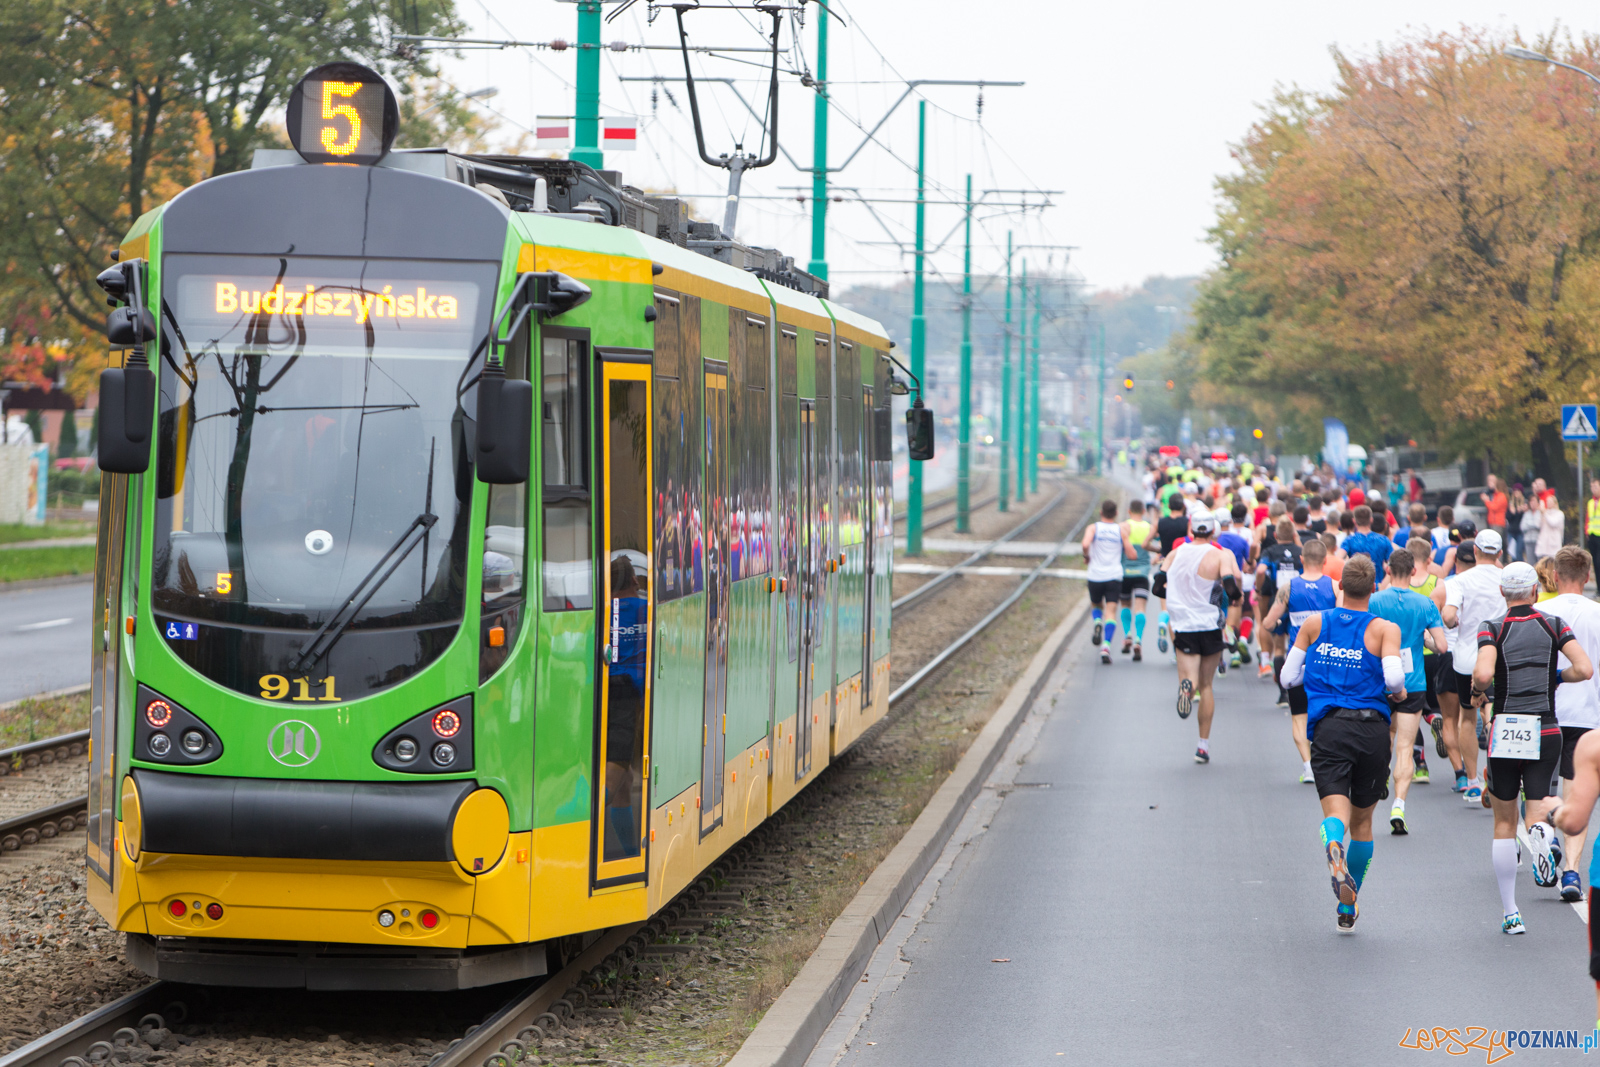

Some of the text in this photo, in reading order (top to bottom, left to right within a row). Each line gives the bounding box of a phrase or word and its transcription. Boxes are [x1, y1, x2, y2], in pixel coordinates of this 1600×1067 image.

[321, 81, 363, 156] 5
[215, 282, 458, 325] Budziszyńska
[216, 572, 232, 594] 5
[1315, 642, 1363, 661] 4Faces
[258, 673, 342, 701] 911
[1502, 729, 1532, 742] 2143
